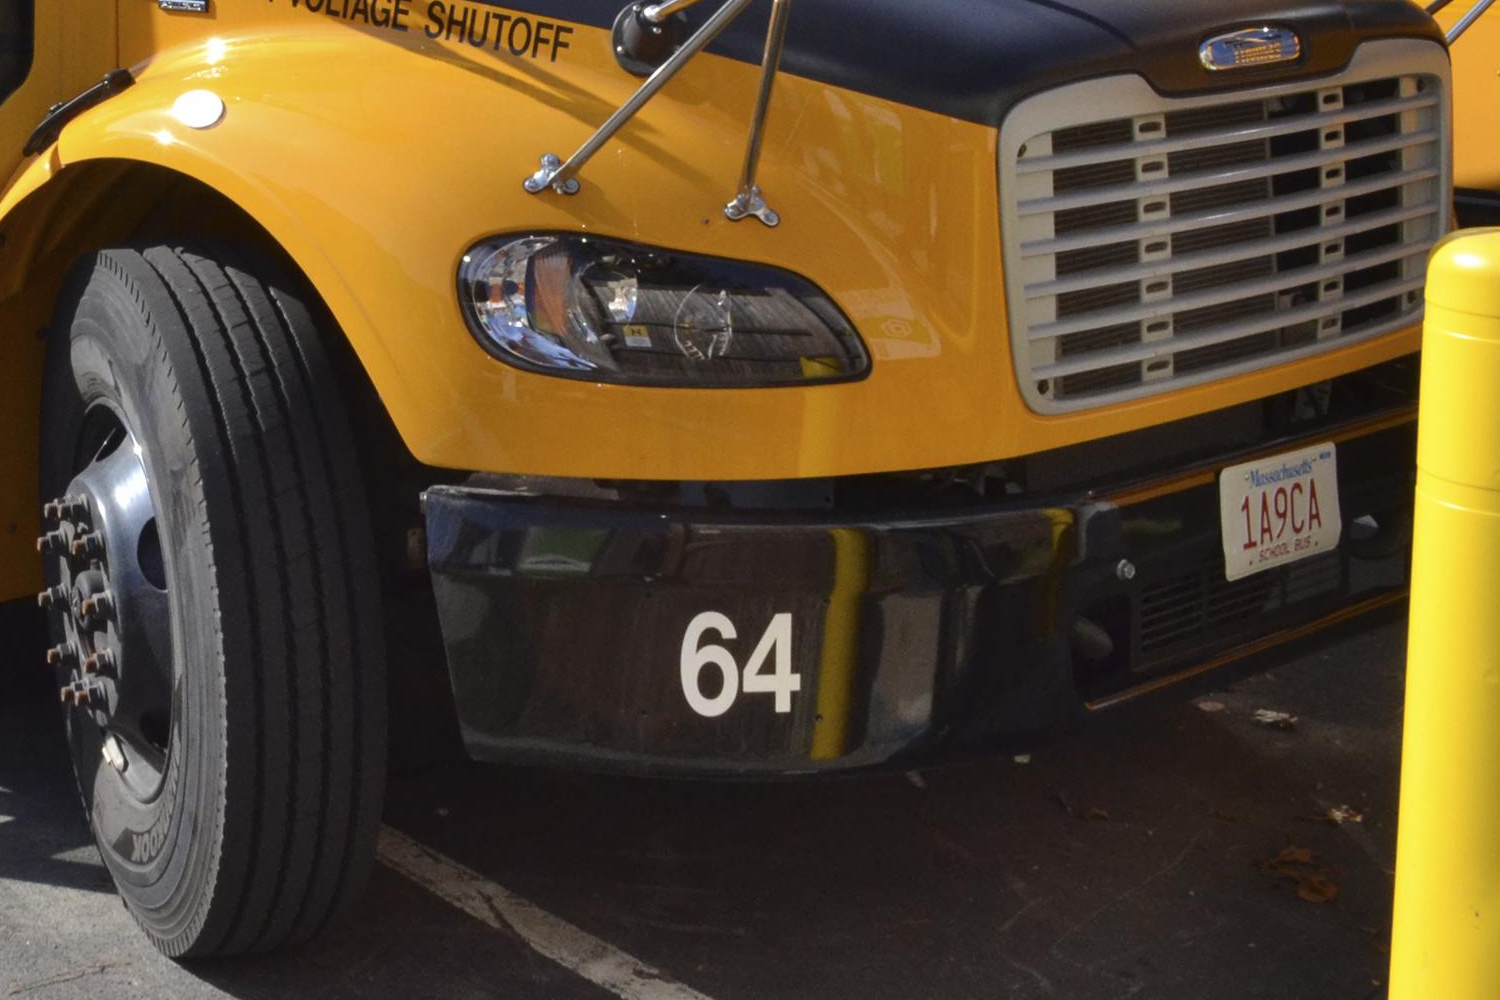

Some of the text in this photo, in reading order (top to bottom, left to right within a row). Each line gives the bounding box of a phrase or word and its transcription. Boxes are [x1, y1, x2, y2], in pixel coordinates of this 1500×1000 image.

[424, 0, 574, 62] SHUTOFF
[1250, 458, 1313, 488] Massachusetts
[1241, 478, 1321, 549] 1A9CA
[1258, 535, 1312, 562] SCHOOL BUS
[680, 610, 801, 718] 64
